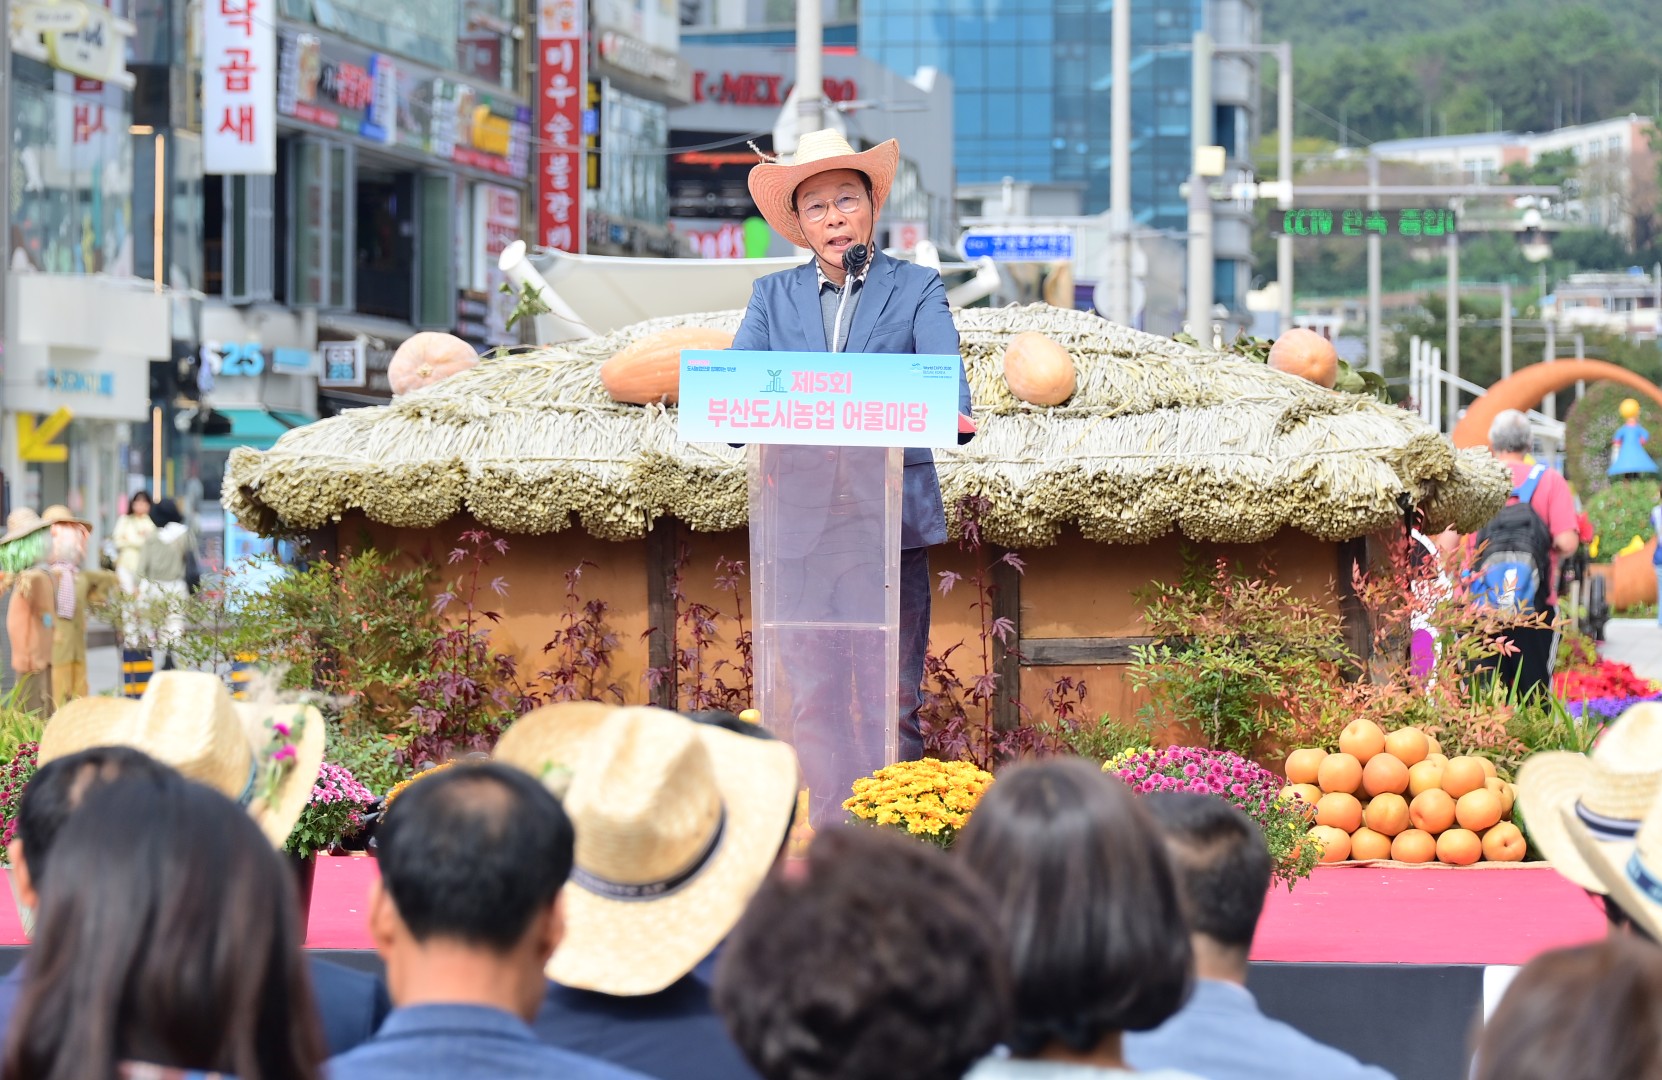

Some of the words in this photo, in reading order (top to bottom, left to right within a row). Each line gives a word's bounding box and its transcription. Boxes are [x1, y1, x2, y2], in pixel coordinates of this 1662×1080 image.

[790, 370, 852, 394] 제5회
[707, 398, 835, 430] 부산도시농업
[842, 400, 928, 433] 어울마당
